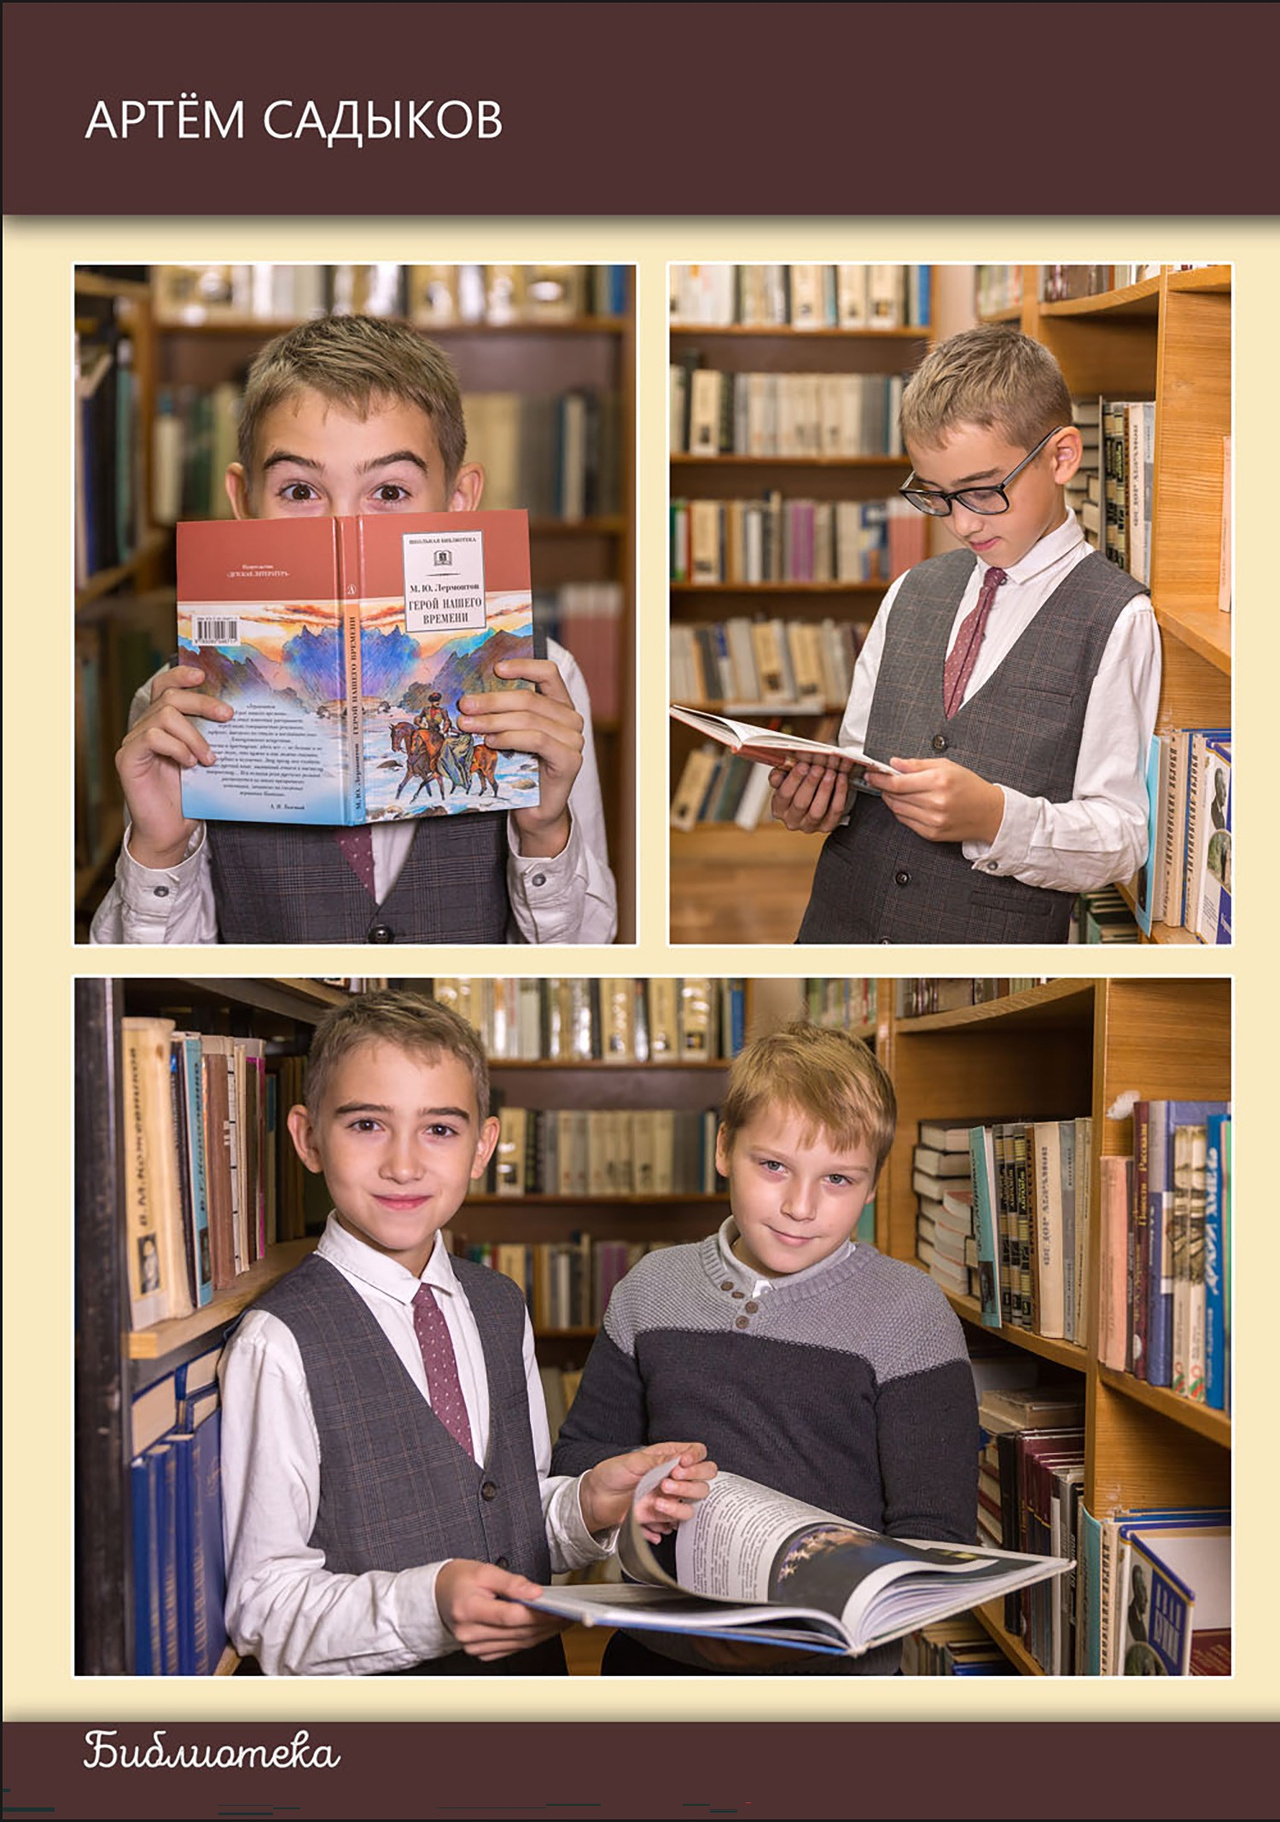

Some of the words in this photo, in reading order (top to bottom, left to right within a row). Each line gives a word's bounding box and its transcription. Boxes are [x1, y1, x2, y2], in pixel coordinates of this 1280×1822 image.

[409, 598, 439, 611] ГЕРОЙ
[443, 598, 482, 609] НАШЕГО
[410, 585, 420, 593] М.
[435, 584, 479, 593] Лермонтов
[423, 613, 468, 624] ВРЕМЕНИ
[349, 616, 357, 661] ВРЕМЕНИ
[350, 663, 358, 703] НАШЕГО
[351, 705, 359, 735] ГЕРОЙ
[1138, 1123, 1149, 1173] Рассказы
[1138, 1183, 1149, 1227] Повести
